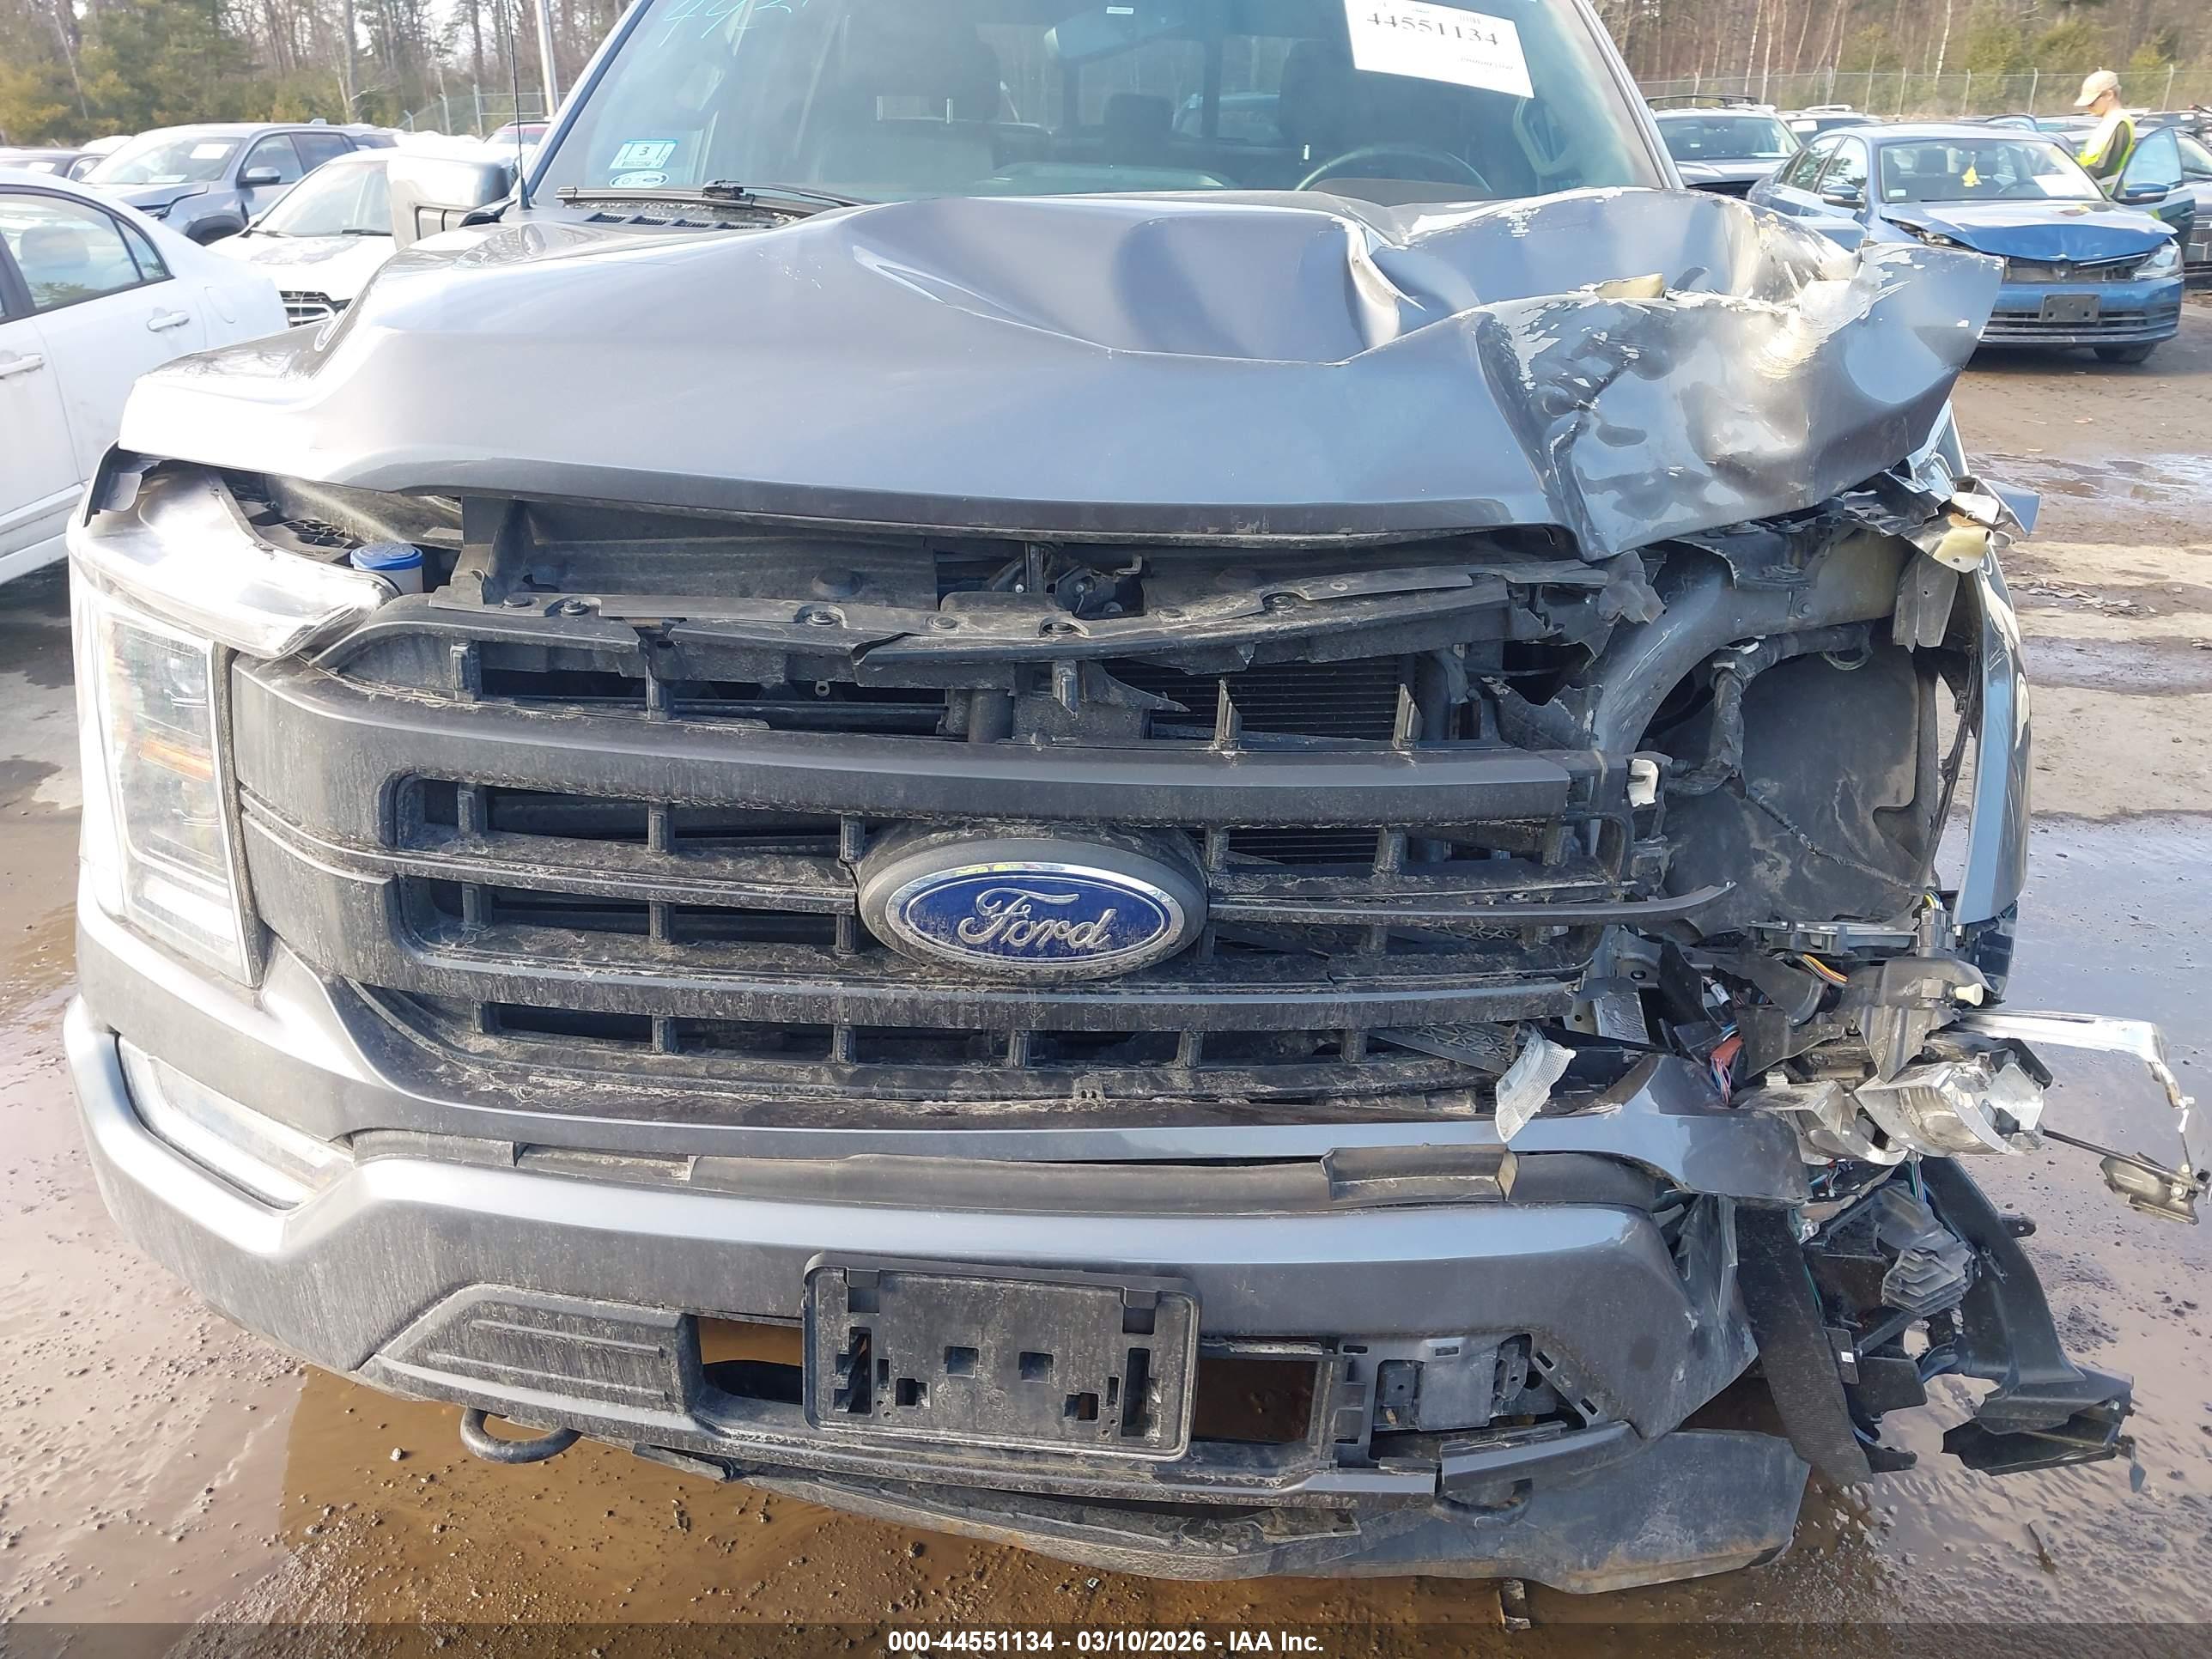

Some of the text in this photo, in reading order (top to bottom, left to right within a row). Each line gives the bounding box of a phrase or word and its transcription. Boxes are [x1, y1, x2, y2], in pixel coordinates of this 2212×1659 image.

[1366, 11, 1499, 46] 44551134
[638, 146, 651, 156] 3
[957, 887, 1118, 949] Ford
